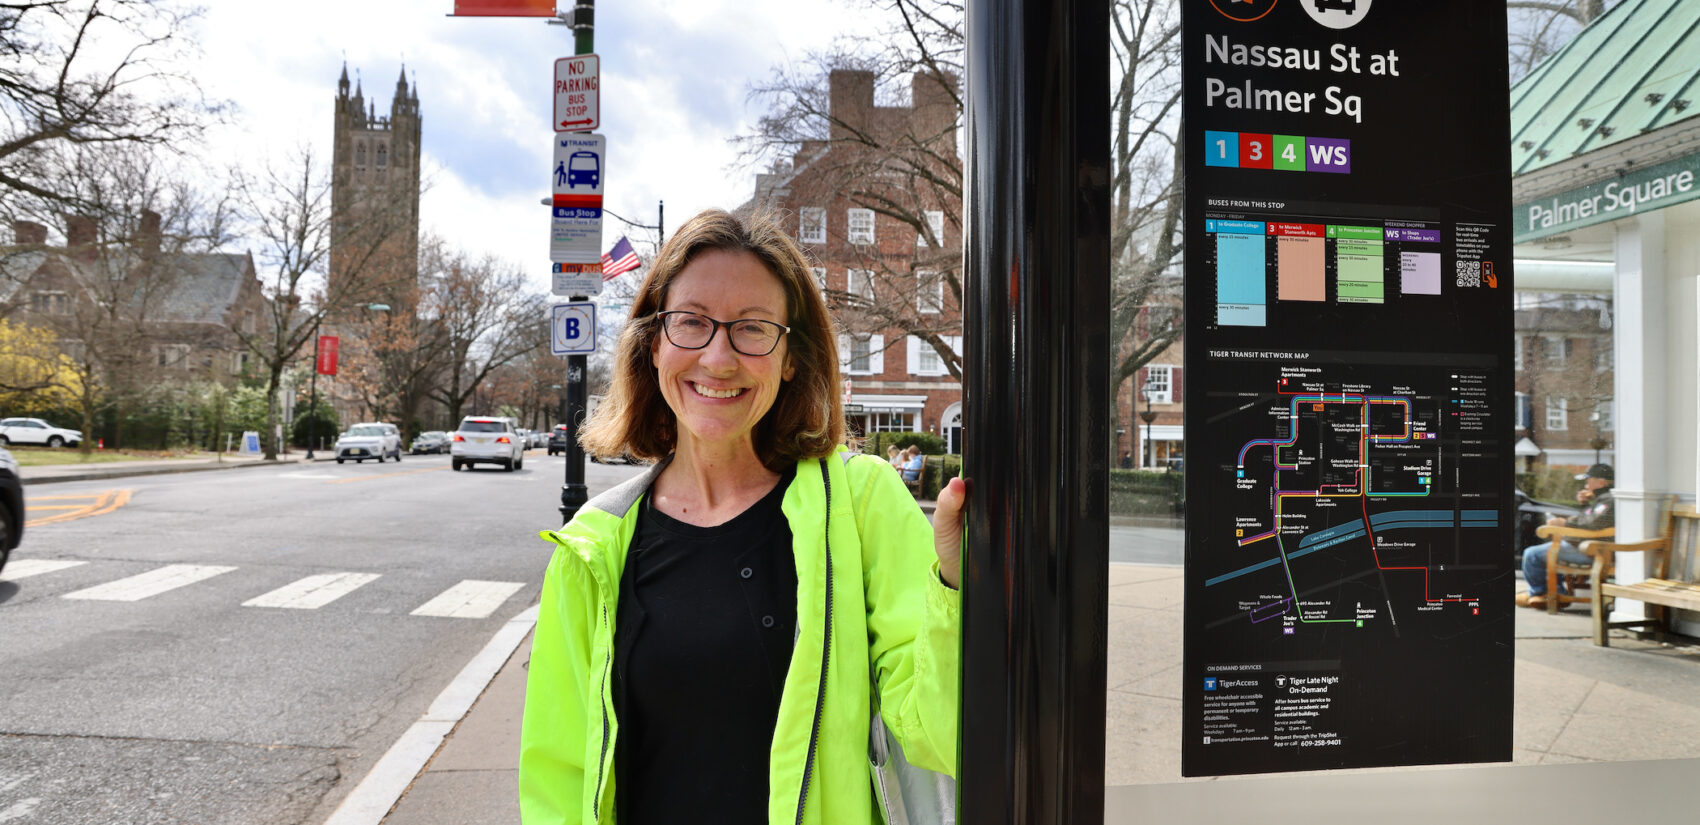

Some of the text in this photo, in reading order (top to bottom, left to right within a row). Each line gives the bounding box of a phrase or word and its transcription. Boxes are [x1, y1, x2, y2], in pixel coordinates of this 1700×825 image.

[1205, 34, 1399, 77] Nassau St at
[568, 61, 585, 75] NO
[556, 77, 597, 94] PARKING
[568, 94, 585, 105] BUS
[1206, 77, 1362, 123] Palmer Sq
[566, 105, 587, 117] STOP
[1216, 139, 1347, 166] 1 3 4 WS
[1529, 170, 1694, 231] Palmer Square
[576, 209, 596, 217] Stop
[1386, 230, 1399, 238] WS
[566, 317, 580, 339] B
[1210, 350, 1229, 358] TIGER
[1219, 680, 1259, 688] TigerAccess
[1289, 677, 1306, 686] Tiger
[1321, 676, 1339, 685] Night
[1289, 685, 1328, 694] On-Demand
[1300, 739, 1341, 747] 609-258-9401
